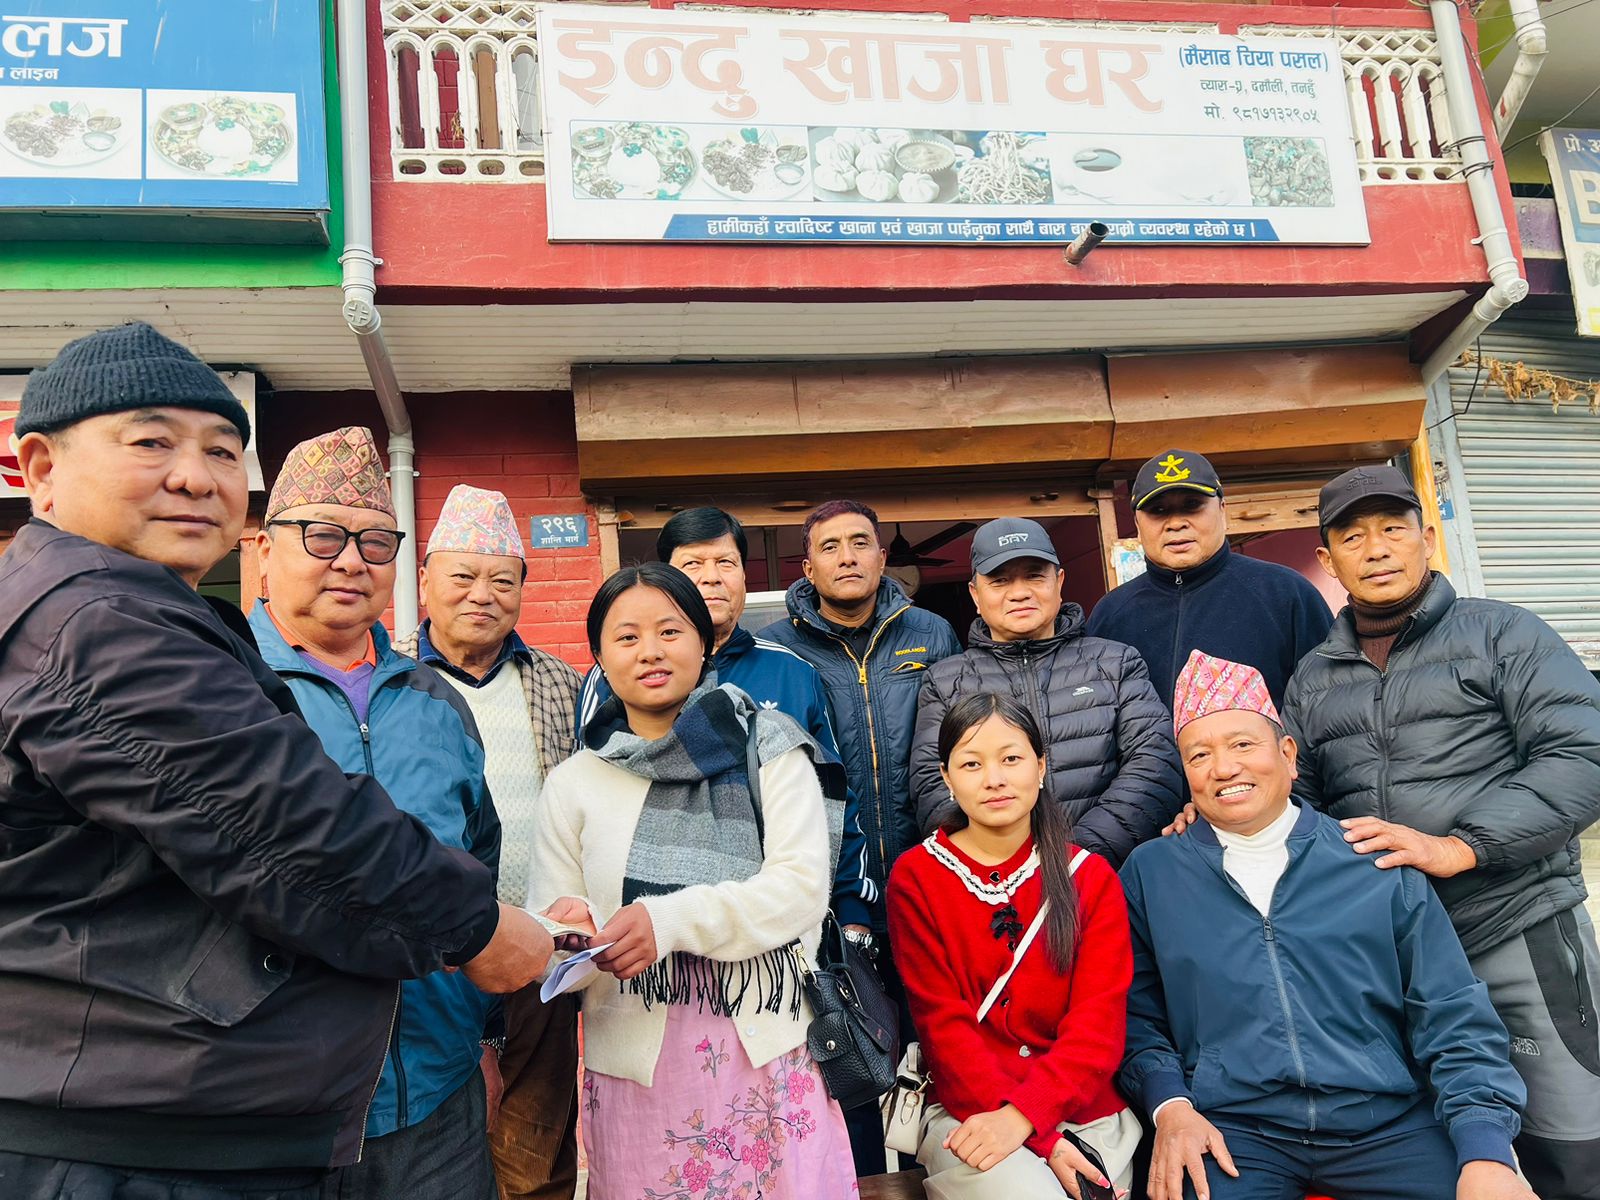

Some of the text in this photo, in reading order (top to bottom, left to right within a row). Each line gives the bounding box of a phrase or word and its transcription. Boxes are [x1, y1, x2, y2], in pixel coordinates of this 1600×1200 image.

[2, 15, 128, 58] लज
[1237, 45, 1274, 67] चिया
[10, 67, 59, 81] लाइन
[552, 18, 1164, 119] इन्दु खाजा घर
[1204, 103, 1225, 120] मो.
[774, 218, 834, 234] स्वादिष्ट
[839, 220, 876, 235] खाना
[881, 218, 901, 236] एवं
[907, 221, 943, 235] खाजा
[1005, 219, 1034, 235] साथै
[1038, 222, 1066, 236] बास
[1139, 222, 1190, 236] व्यवस्था
[1194, 220, 1229, 237] रहेको
[1232, 223, 1246, 236] छ
[541, 517, 577, 534] २९६
[541, 534, 579, 545] शान्ति मार्ग
